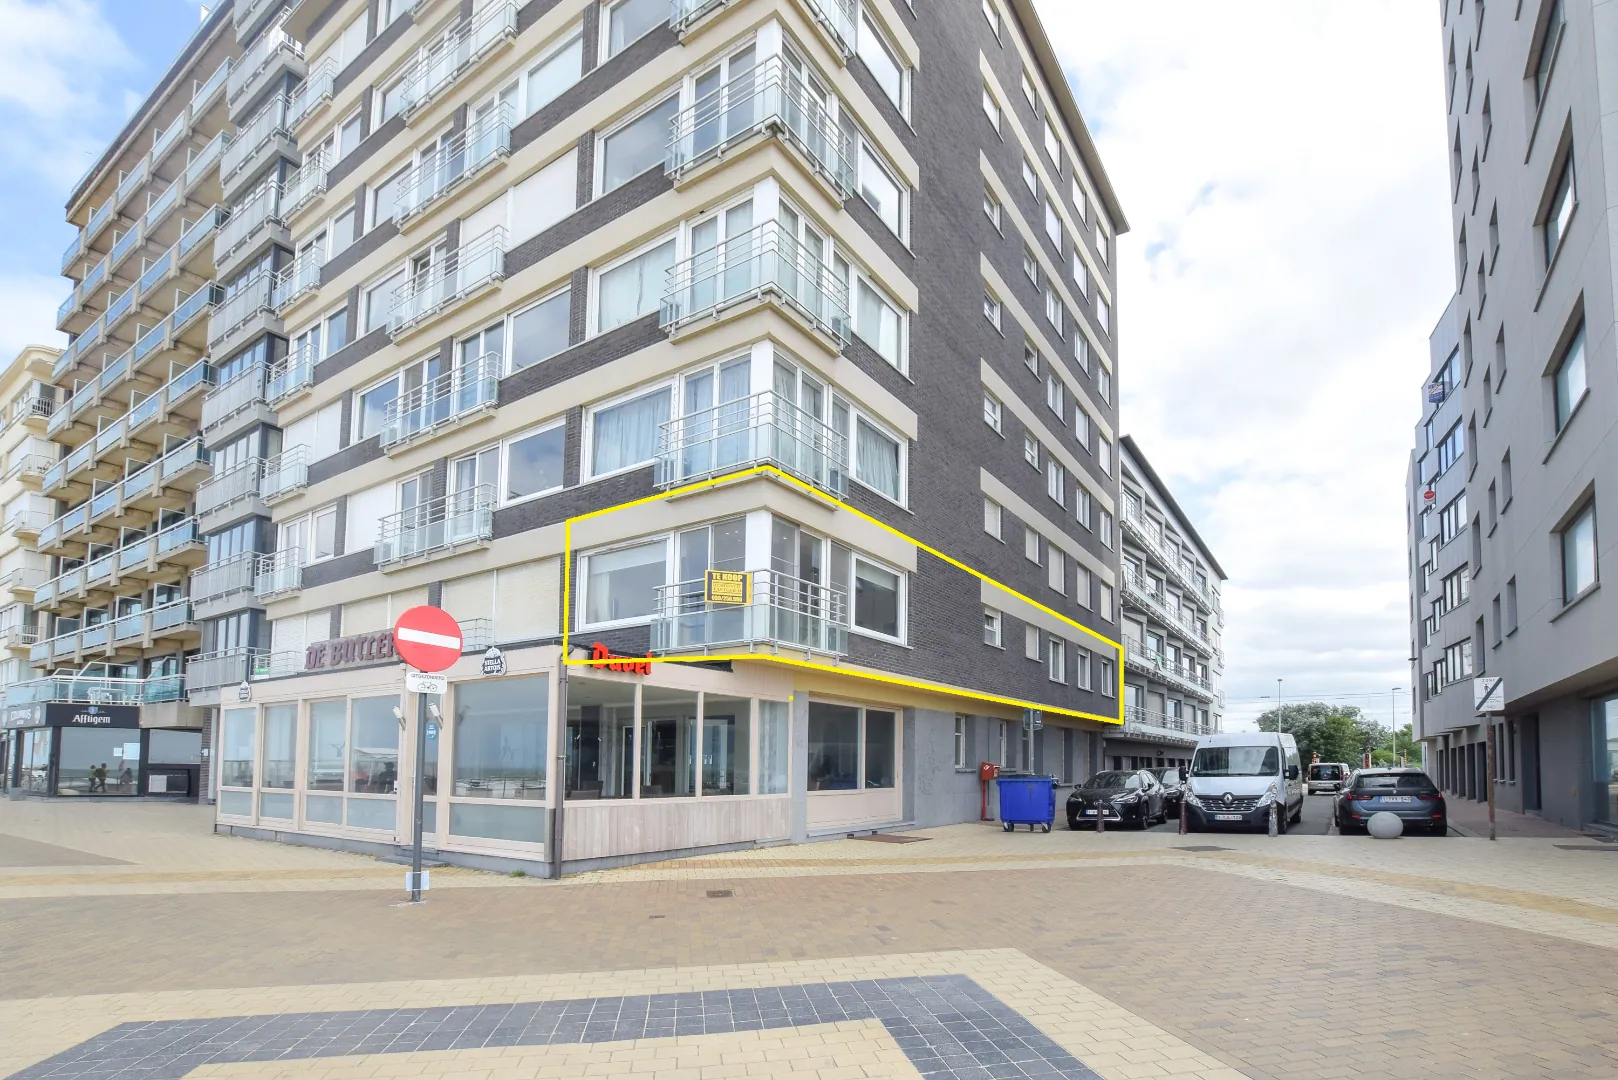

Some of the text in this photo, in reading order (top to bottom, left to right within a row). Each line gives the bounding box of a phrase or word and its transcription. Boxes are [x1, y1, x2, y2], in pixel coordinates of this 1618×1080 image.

[722, 574, 743, 582] KOOP
[304, 643, 326, 669] DE
[592, 641, 652, 675] Duvel
[485, 658, 500, 666] STELLA
[411, 673, 446, 681] UITGEZONDERD
[72, 714, 111, 724] Affligem
